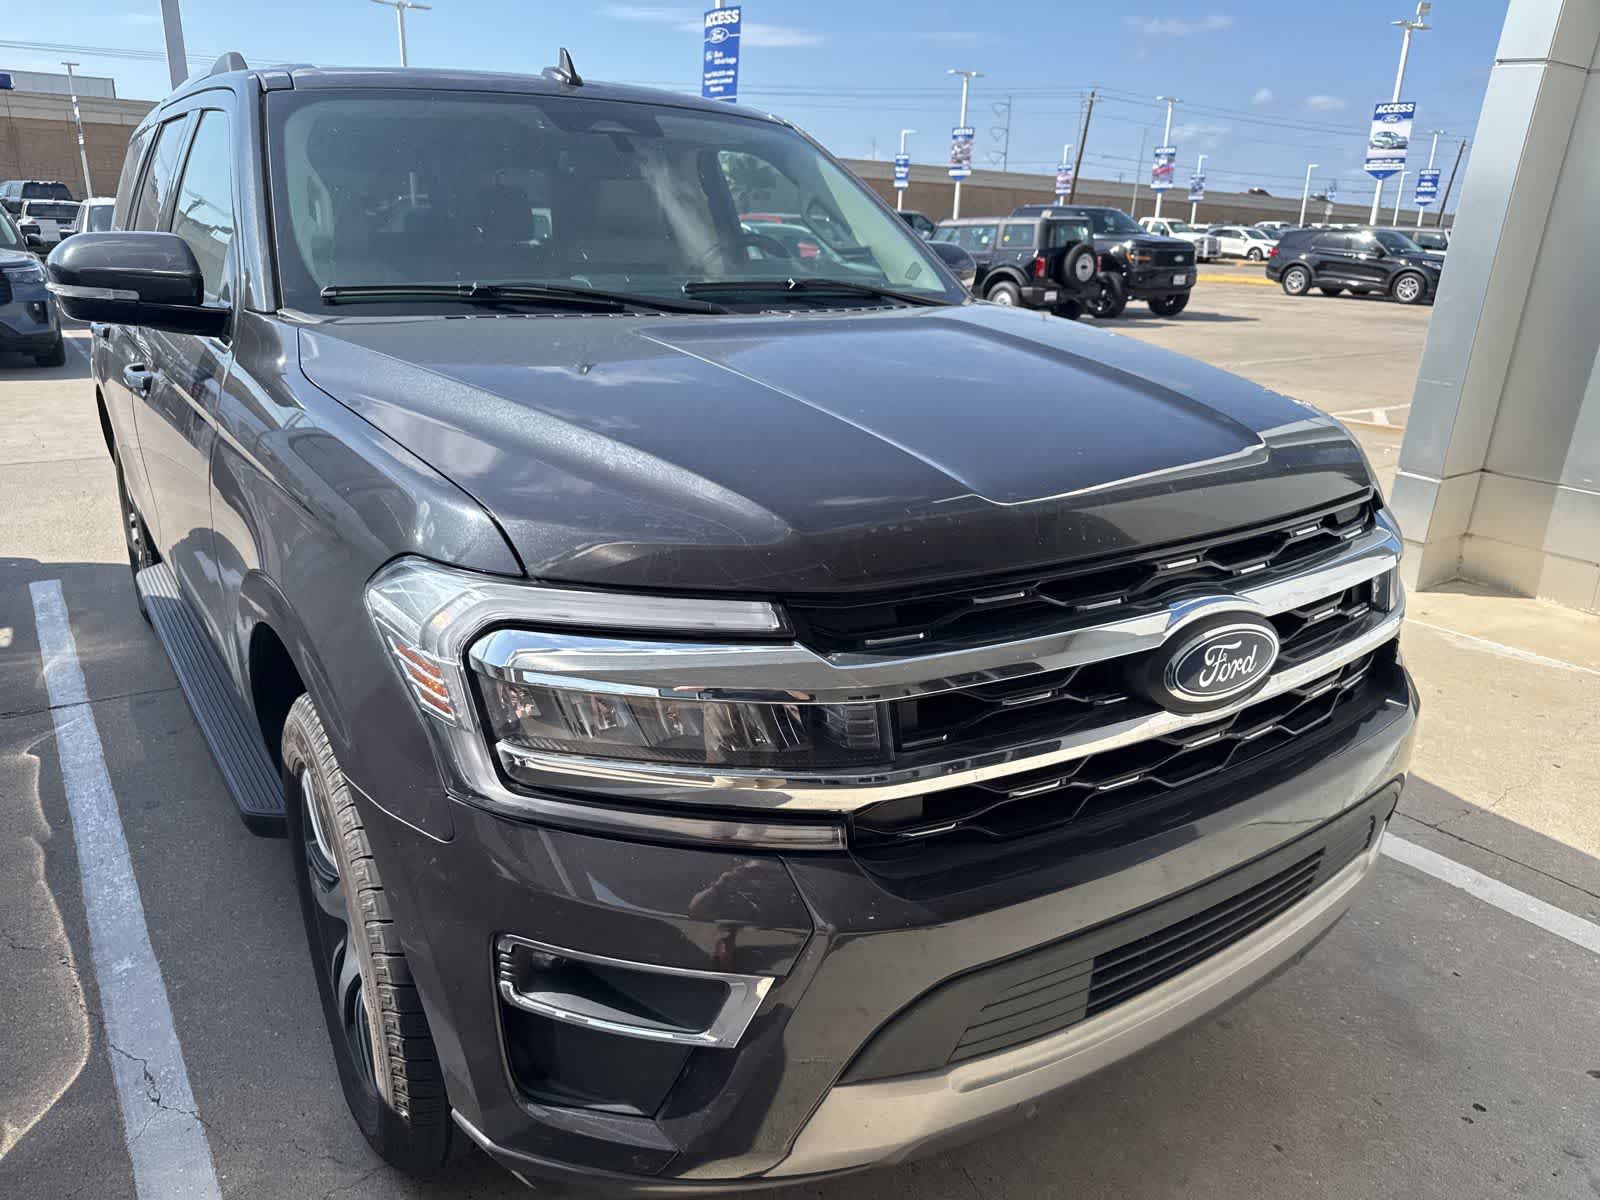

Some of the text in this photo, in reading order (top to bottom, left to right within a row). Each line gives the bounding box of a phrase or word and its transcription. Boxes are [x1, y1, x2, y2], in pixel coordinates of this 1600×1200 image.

[705, 9, 740, 27] ACCESS
[1375, 103, 1414, 114] ACCESS
[1198, 640, 1258, 688] Ford
